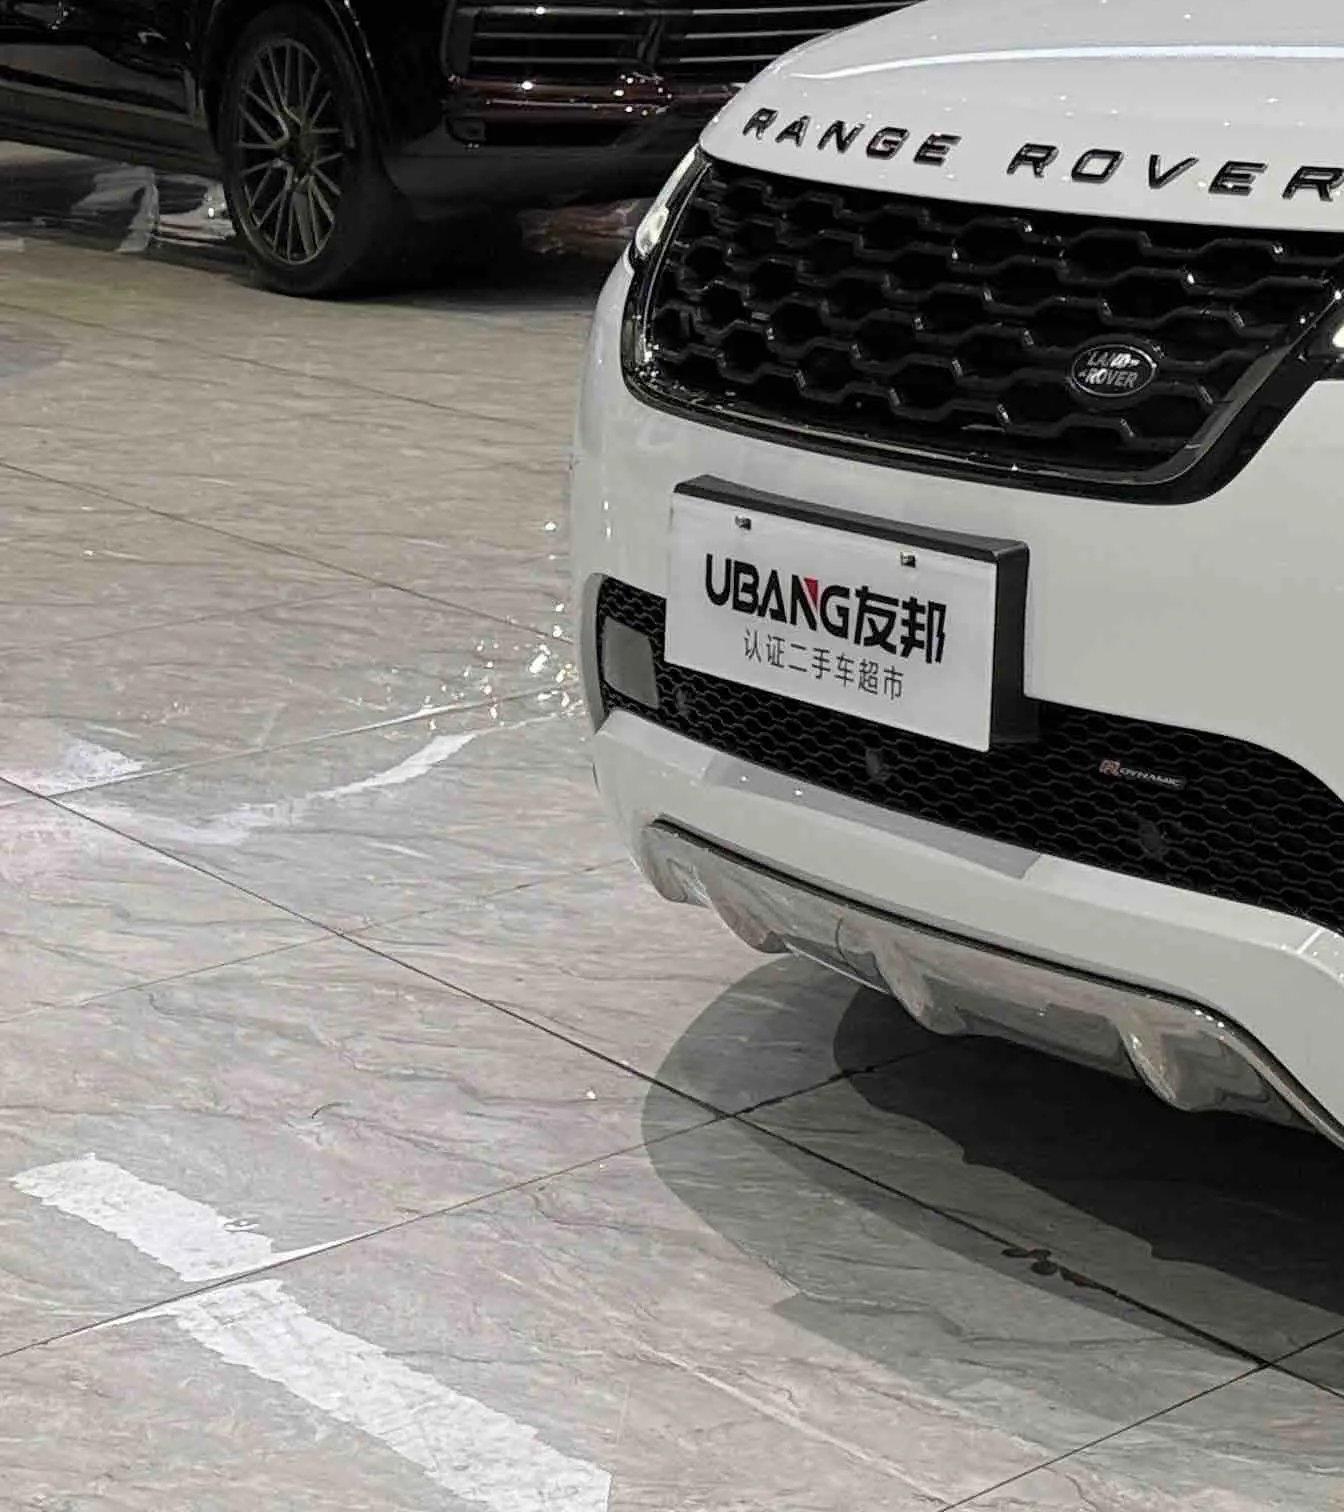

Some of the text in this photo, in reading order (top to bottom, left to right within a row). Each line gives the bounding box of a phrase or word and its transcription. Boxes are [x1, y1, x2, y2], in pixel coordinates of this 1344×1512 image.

[742, 107, 962, 167] RANGE
[1085, 368, 1139, 388] ROVER
[705, 552, 947, 664] UBANG友邦
[744, 628, 904, 701] 认证二手车超市
